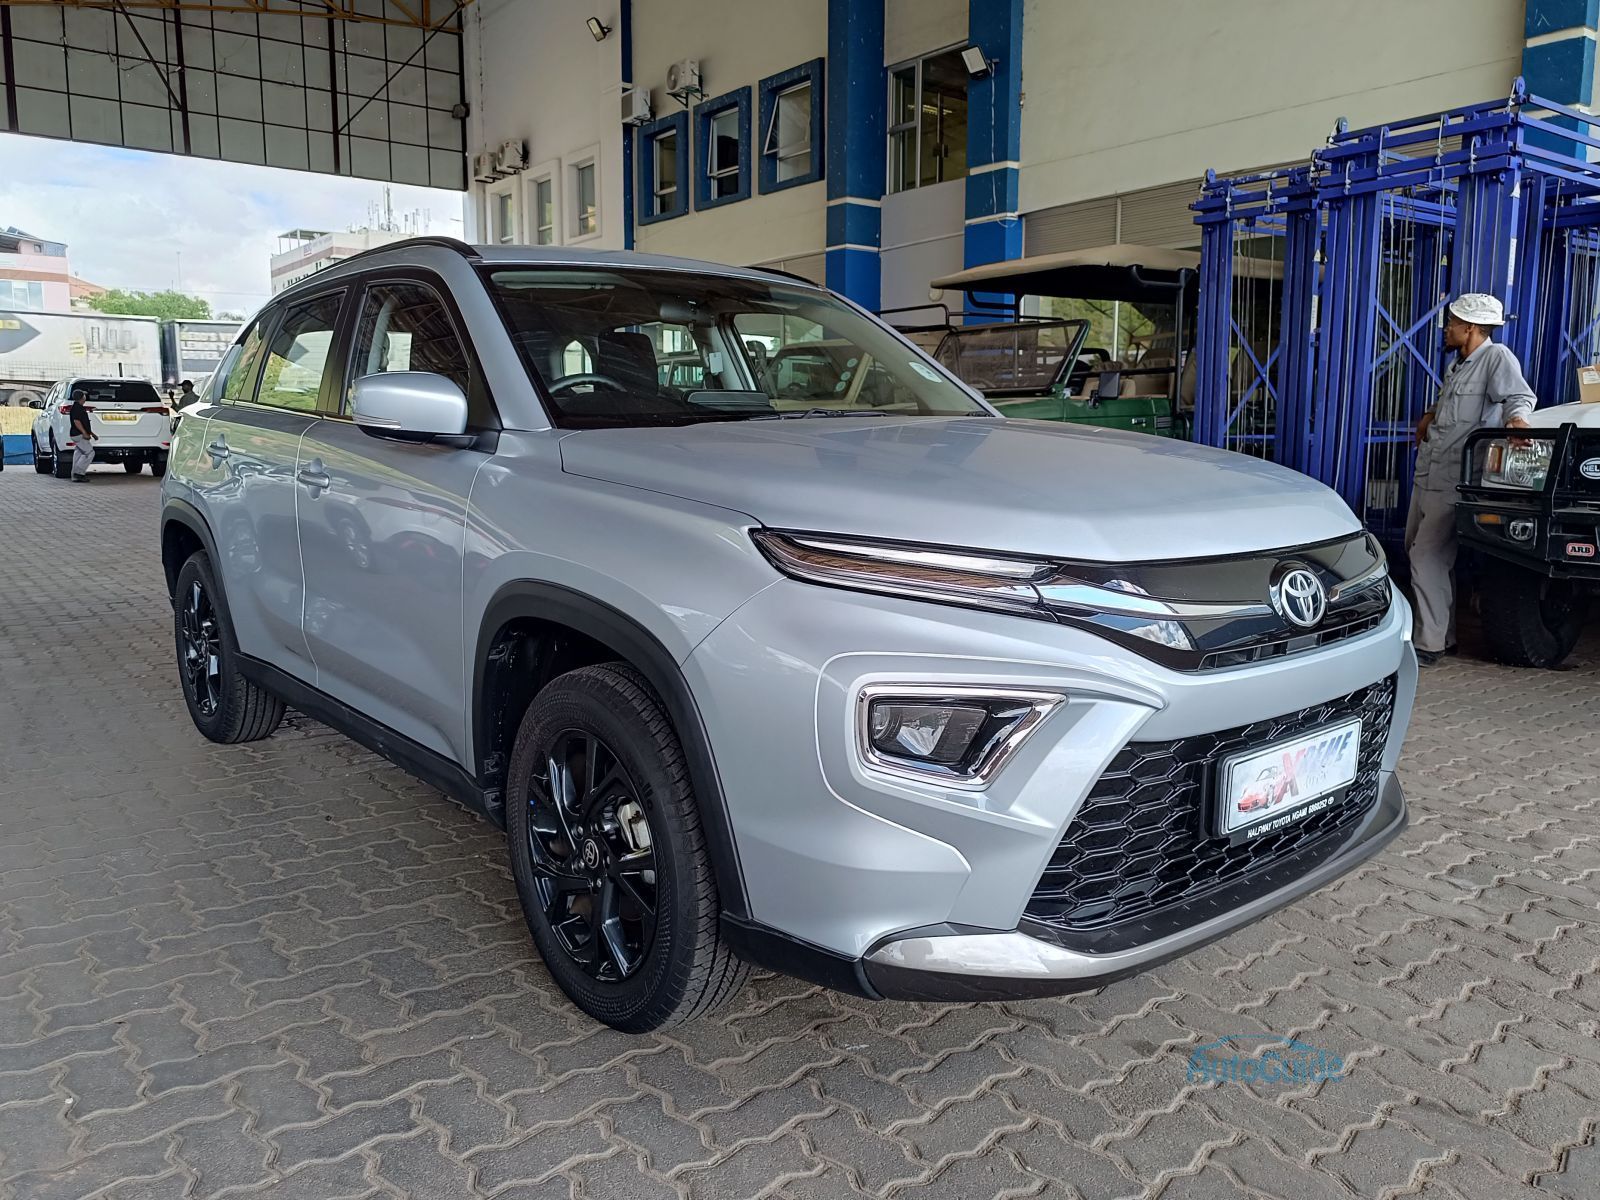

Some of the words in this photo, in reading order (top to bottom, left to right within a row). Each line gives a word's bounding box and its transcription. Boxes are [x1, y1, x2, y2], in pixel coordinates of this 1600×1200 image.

[1570, 546, 1591, 554] ARB
[1247, 821, 1273, 839] HALFWAY
[1272, 814, 1291, 829] TOYOTA
